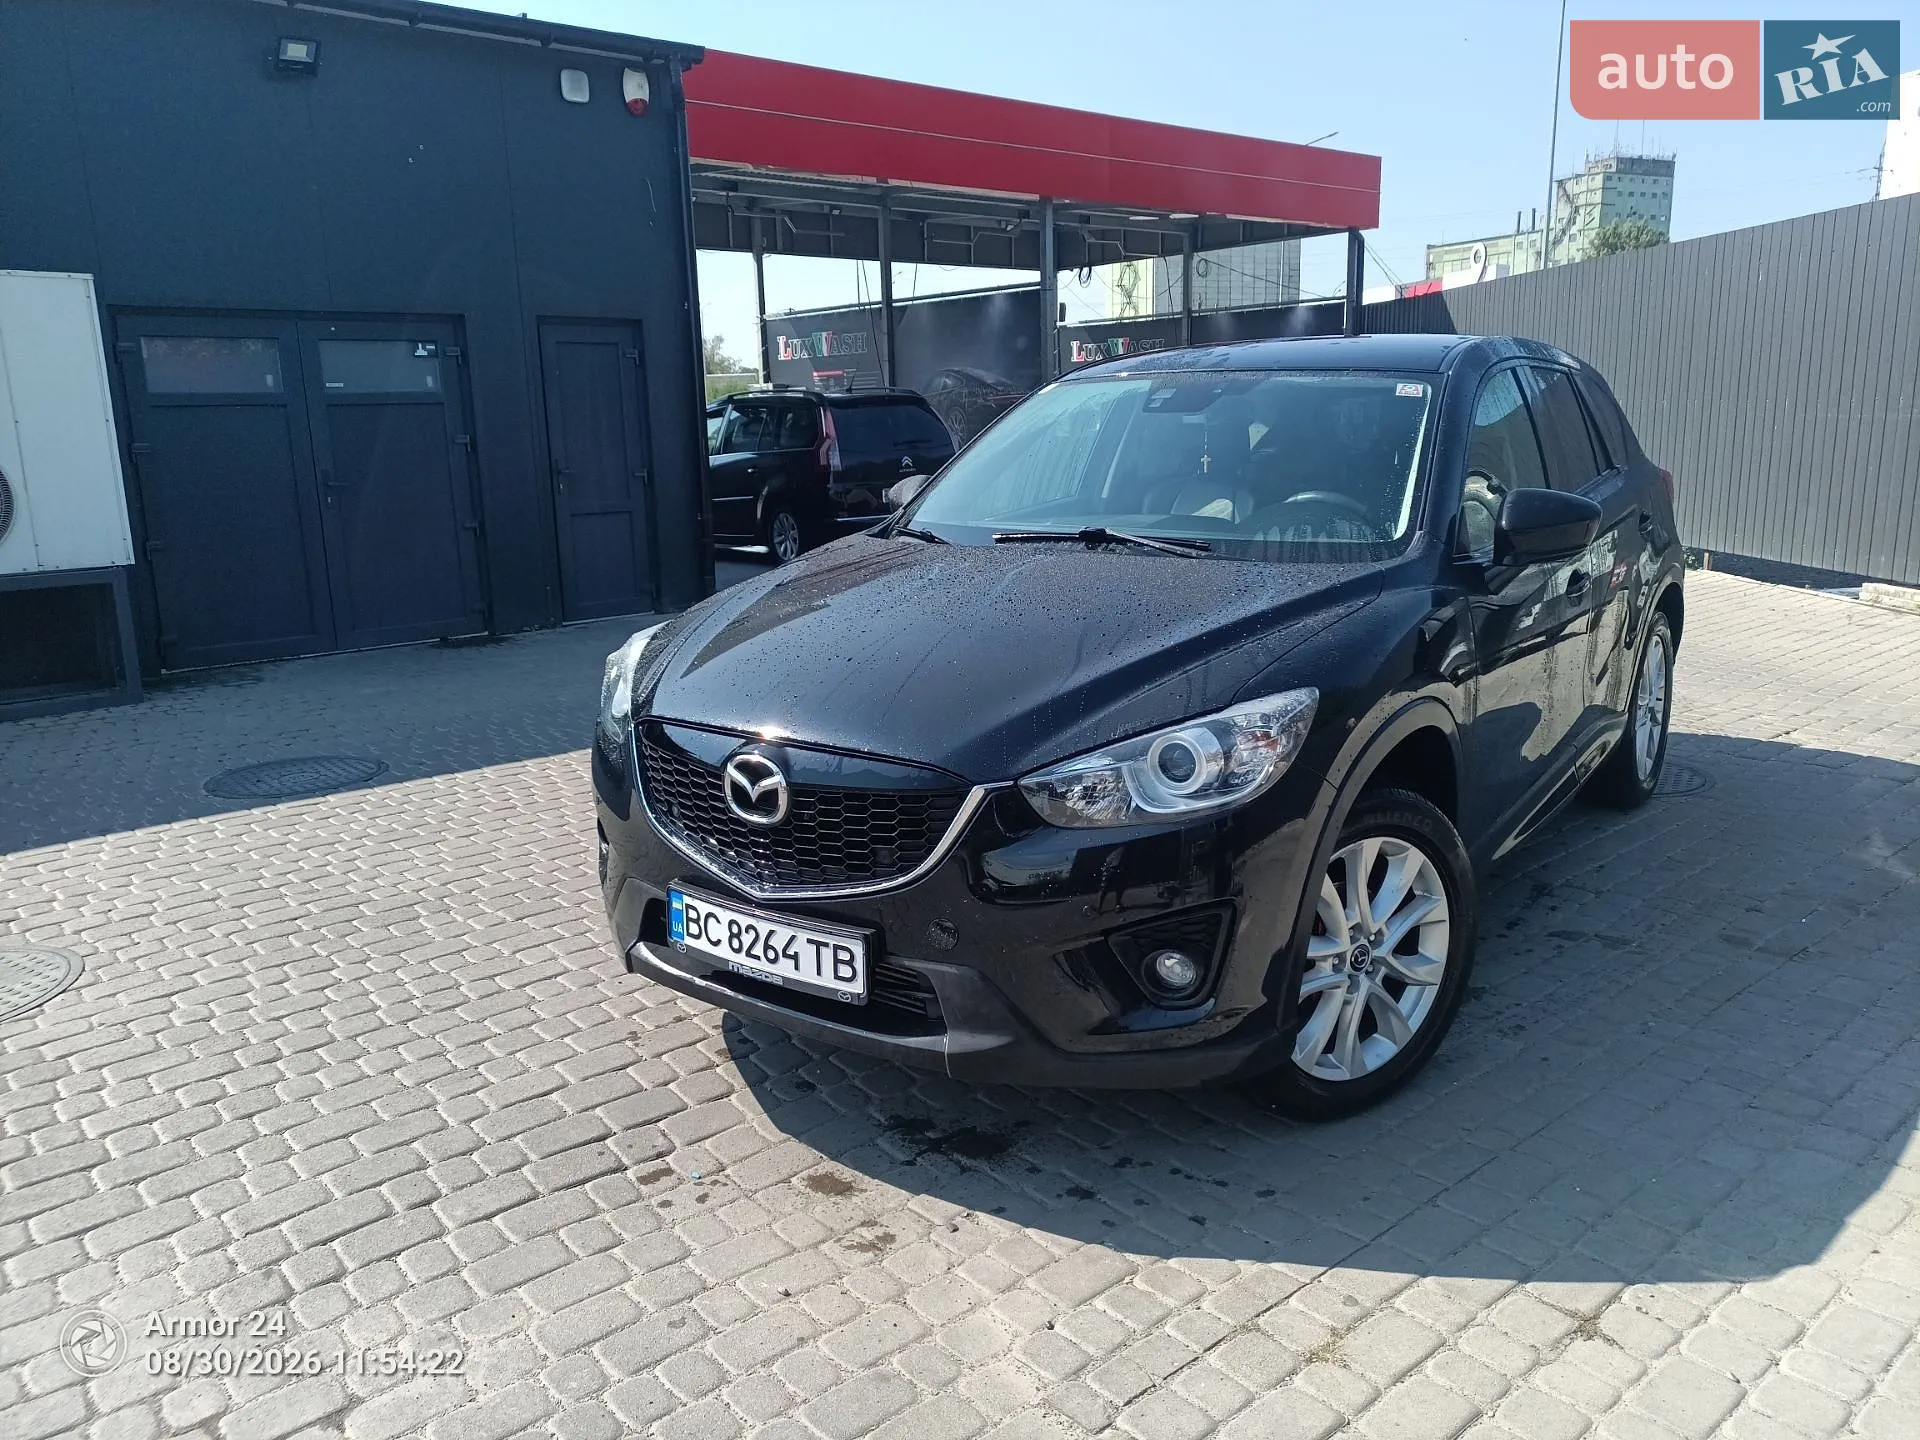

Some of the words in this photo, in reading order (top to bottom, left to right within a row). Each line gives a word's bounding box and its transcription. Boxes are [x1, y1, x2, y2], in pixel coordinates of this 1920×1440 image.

[672, 921, 684, 934] UA
[684, 902, 722, 948] BC
[727, 919, 800, 972] 8264
[806, 938, 858, 983] TB
